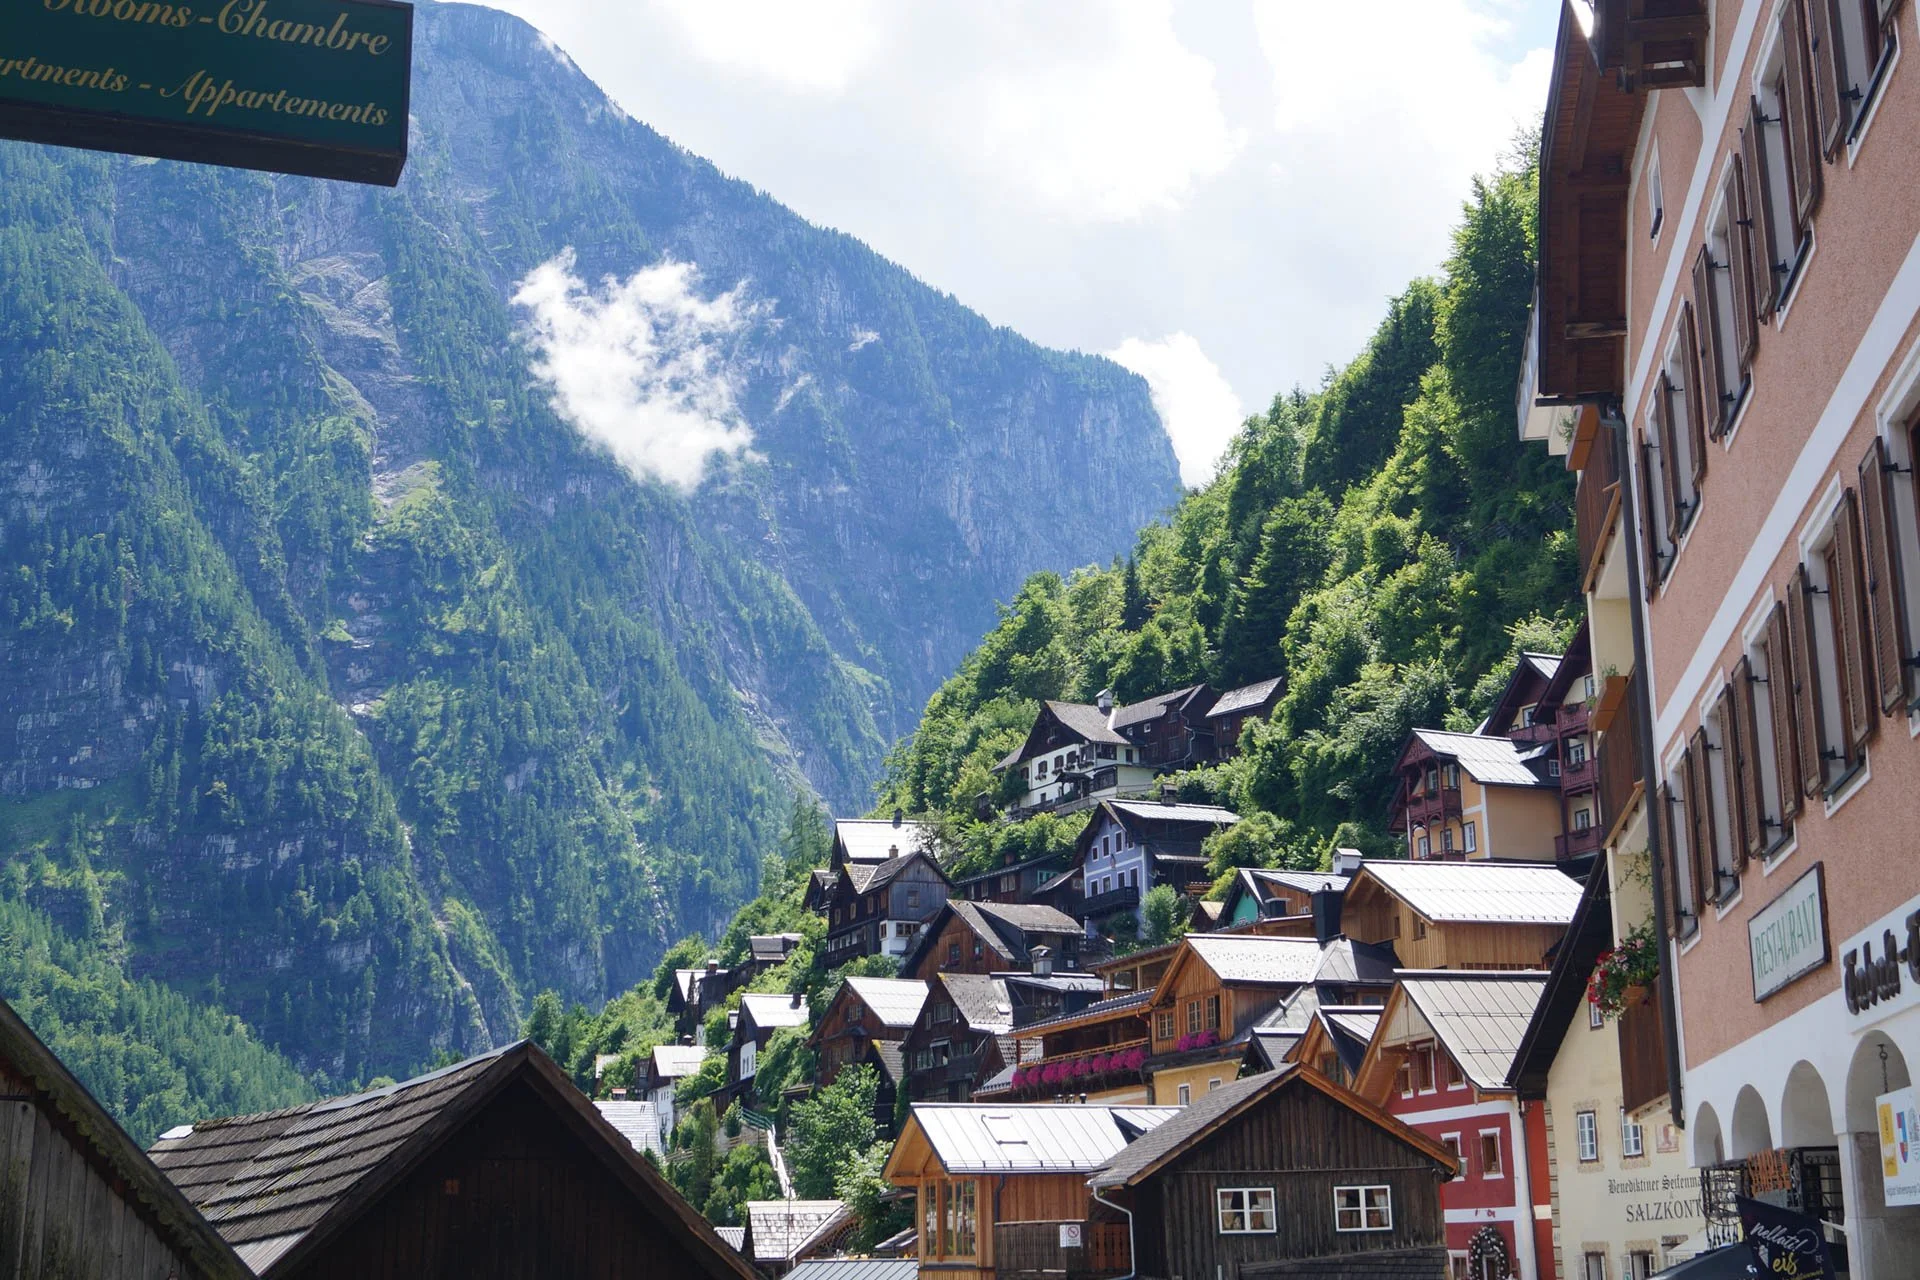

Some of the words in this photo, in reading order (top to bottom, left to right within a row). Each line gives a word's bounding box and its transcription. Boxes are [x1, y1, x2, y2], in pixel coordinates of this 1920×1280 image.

[160, 69, 390, 126] Appartements
[1754, 893, 1818, 979] RESTAURANT
[1608, 1179, 1660, 1195] Benediktiner
[1626, 1198, 1702, 1223] SALZKONT
